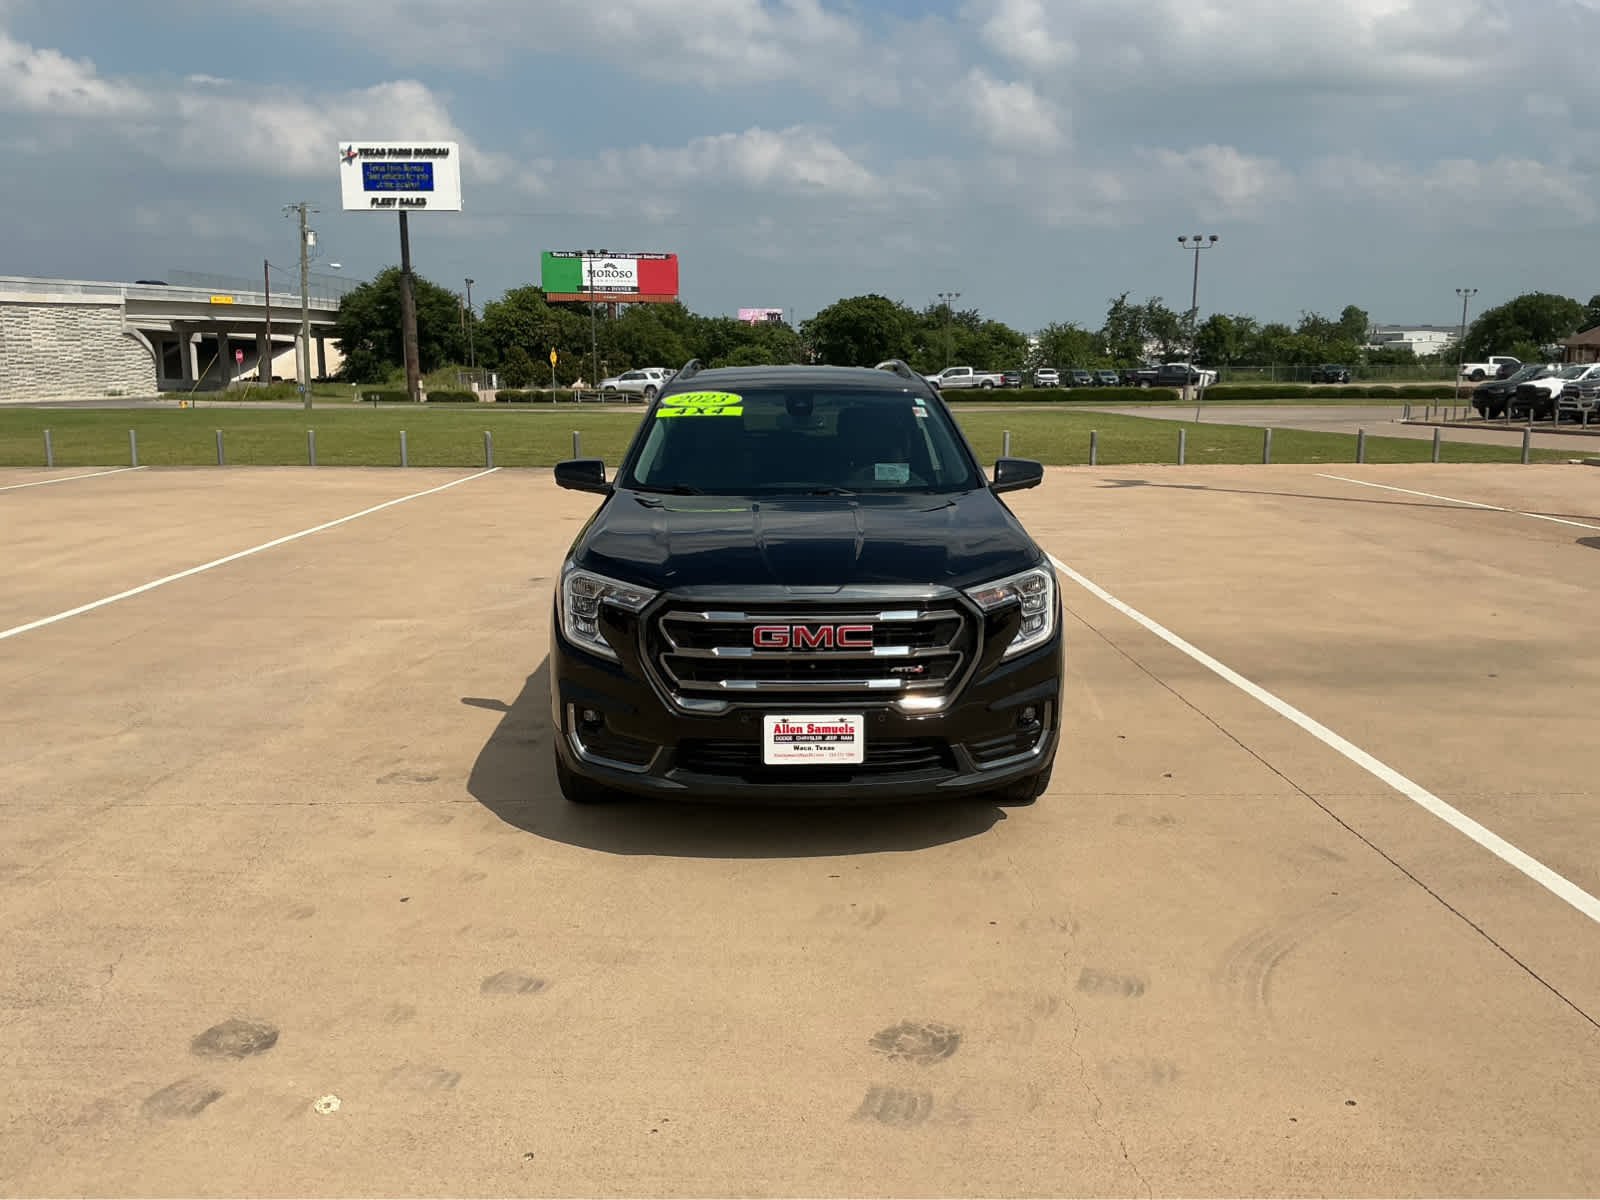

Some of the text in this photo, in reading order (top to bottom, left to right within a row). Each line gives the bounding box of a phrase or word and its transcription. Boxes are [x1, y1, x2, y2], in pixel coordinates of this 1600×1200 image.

[358, 148, 450, 158] TEXAS FARM BUREAU
[370, 197, 427, 207] FLEET SALES
[587, 269, 632, 278] MOROSO
[752, 625, 873, 648] GMC
[774, 723, 855, 734] Allen Samuels
